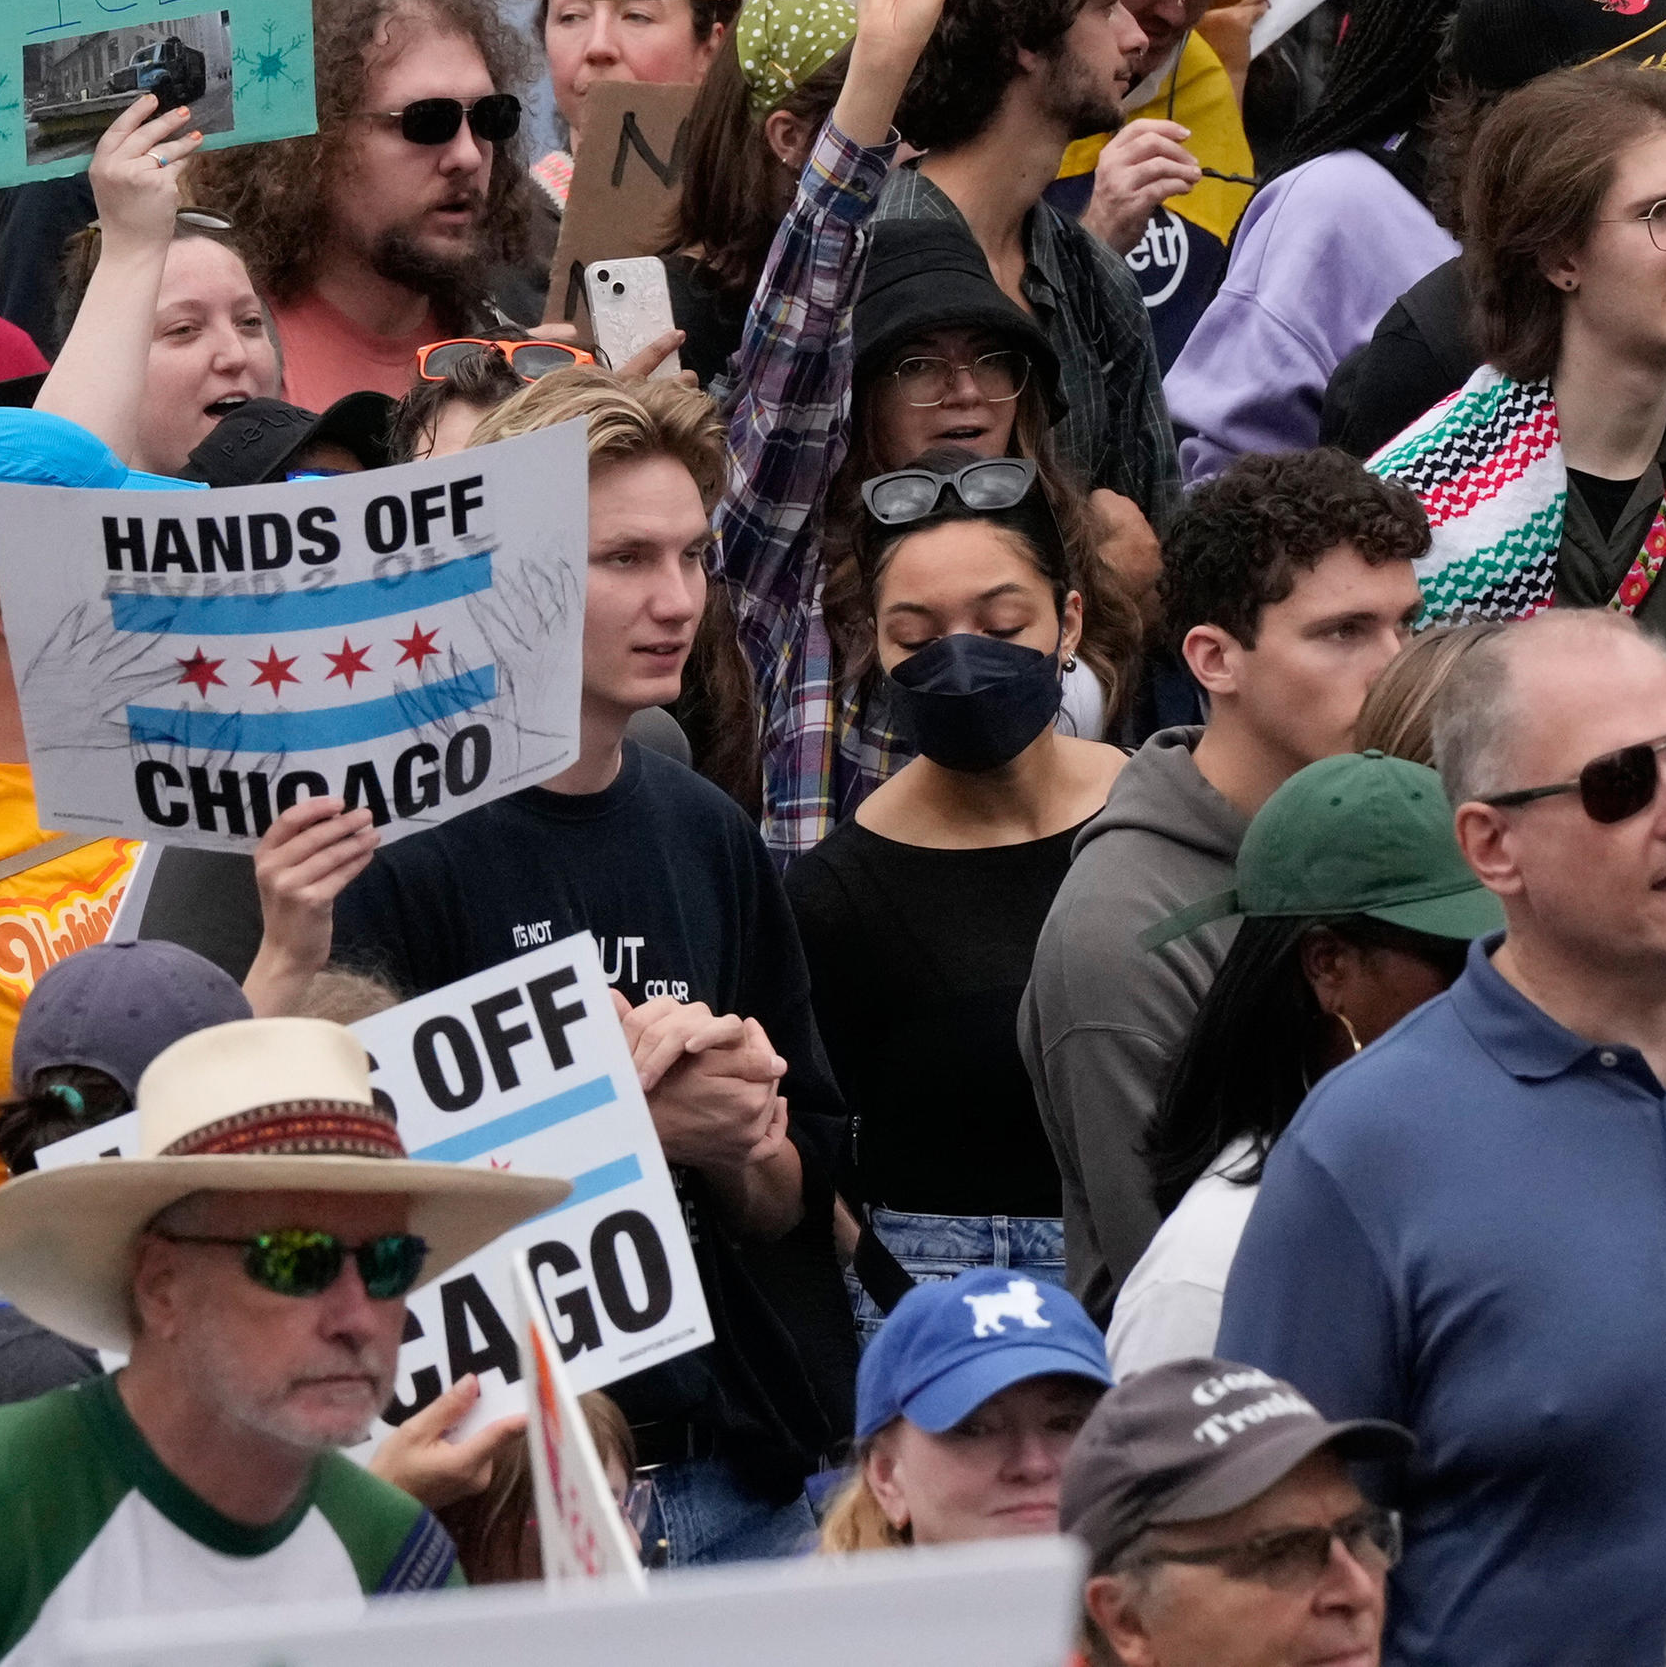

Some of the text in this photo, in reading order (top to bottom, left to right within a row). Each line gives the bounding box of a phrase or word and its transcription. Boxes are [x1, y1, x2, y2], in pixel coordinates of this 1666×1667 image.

[102, 474, 485, 575] HANDS OFF
[135, 724, 493, 837] CHICAGO
[412, 963, 589, 1114] OFF
